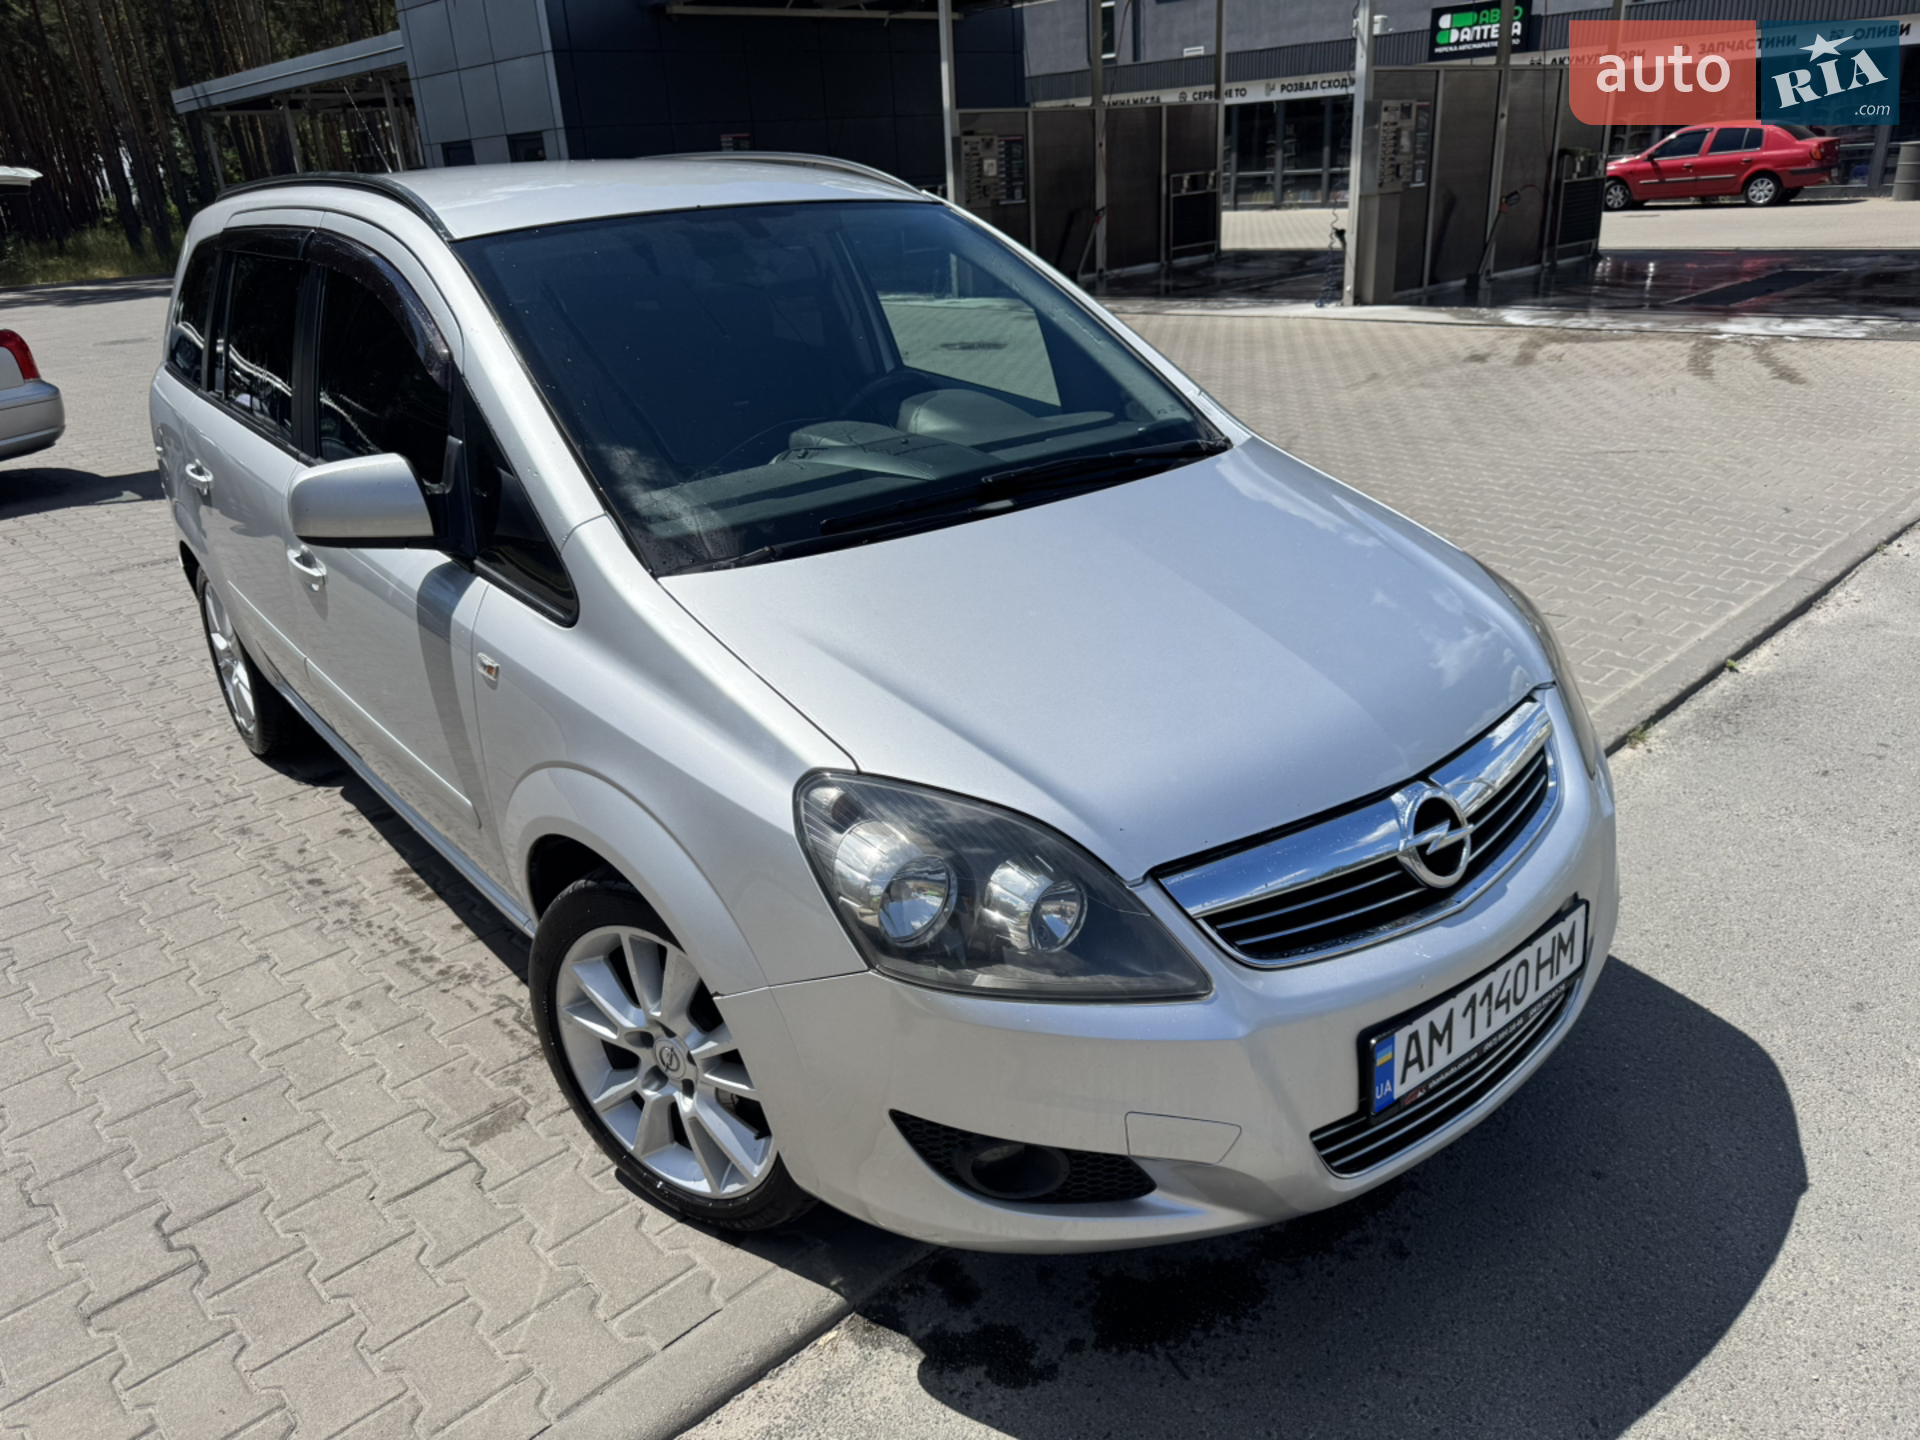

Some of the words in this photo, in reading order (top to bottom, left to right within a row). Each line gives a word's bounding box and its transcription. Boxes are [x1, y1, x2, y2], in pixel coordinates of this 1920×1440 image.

[1478, 5, 1524, 25] АВО
[1459, 21, 1523, 42] АПТЕА
[1853, 23, 1912, 41] ОЛИВИ
[1697, 34, 1798, 55] ЗАПЧАСТИНИ
[1235, 87, 1248, 98] ТО
[1280, 80, 1318, 94] РОЗВАЛ
[1400, 1007, 1455, 1085] AM
[1461, 958, 1530, 1040] 1140
[1534, 920, 1577, 993] HM
[1375, 1079, 1393, 1100] UA
